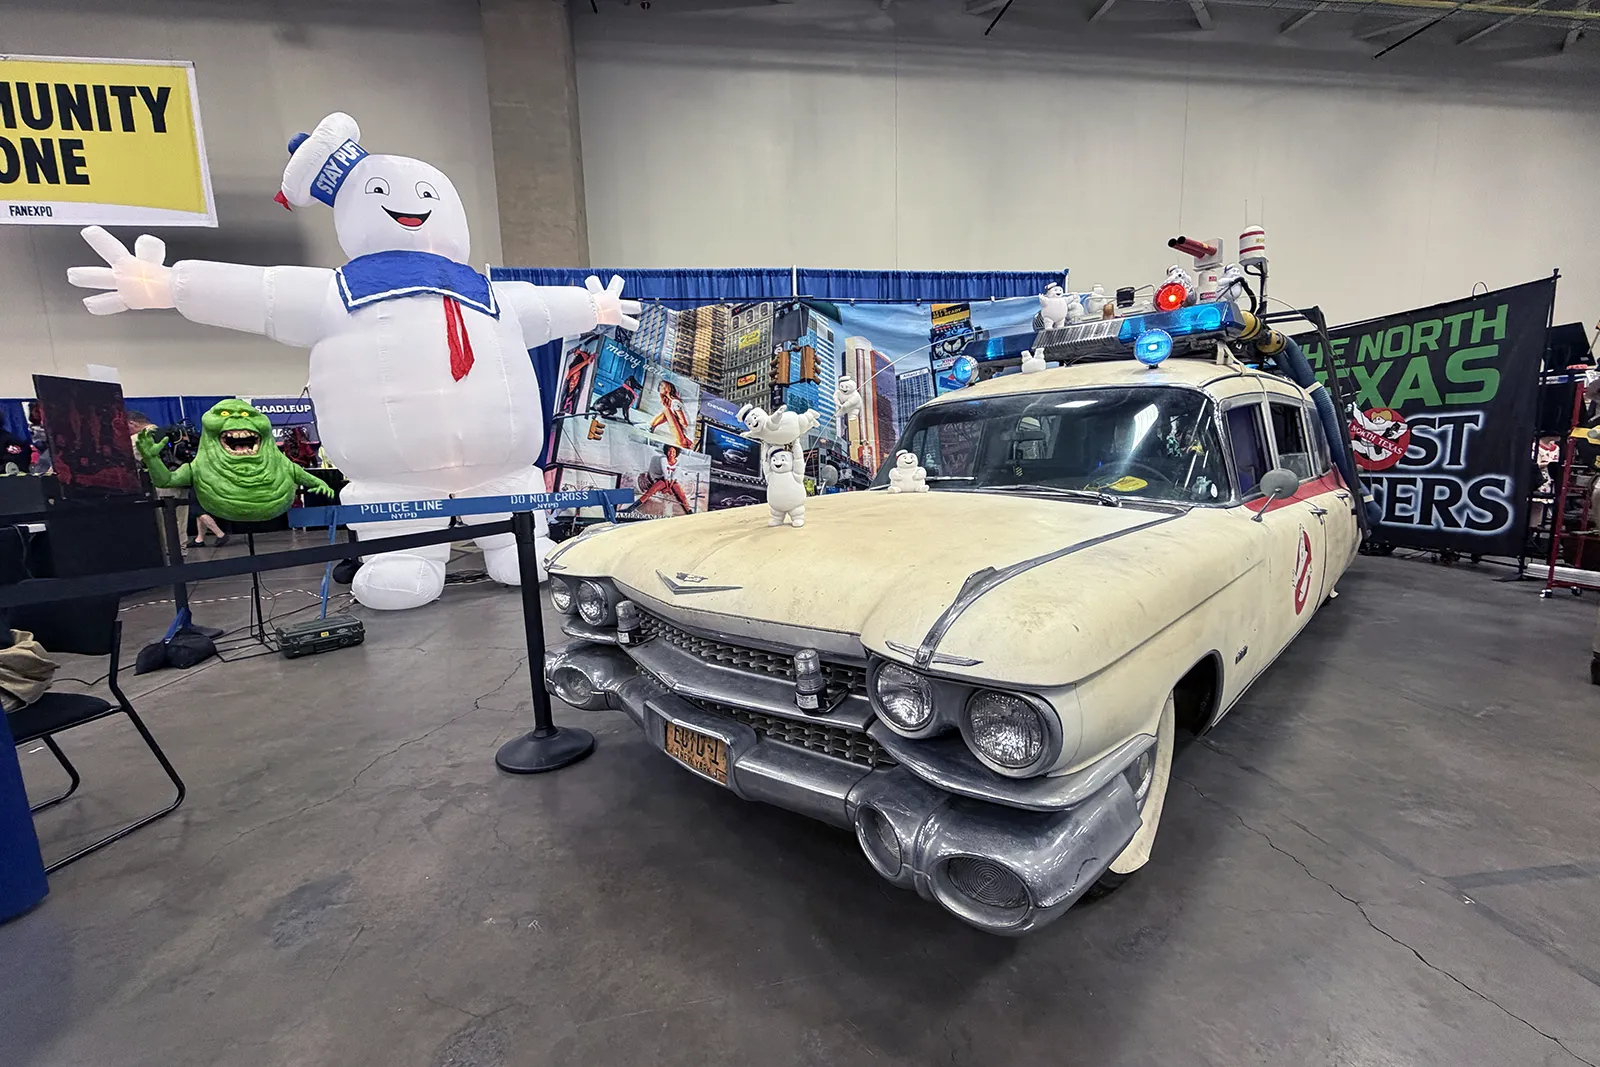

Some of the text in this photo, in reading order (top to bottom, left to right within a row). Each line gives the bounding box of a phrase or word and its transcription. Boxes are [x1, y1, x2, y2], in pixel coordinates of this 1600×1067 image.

[0, 137, 90, 185] ONE
[316, 158, 344, 195] STAY
[9, 205, 53, 217] FANEXPO
[1300, 303, 1509, 369] HE NORTH
[606, 343, 641, 369] merry
[255, 404, 312, 414] SAADLEUP
[1350, 424, 1404, 455] NORTH TEXAS
[360, 500, 443, 515] POLICE LINE
[510, 491, 589, 505] DO NOT CROSS
[390, 511, 418, 520] NYPD
